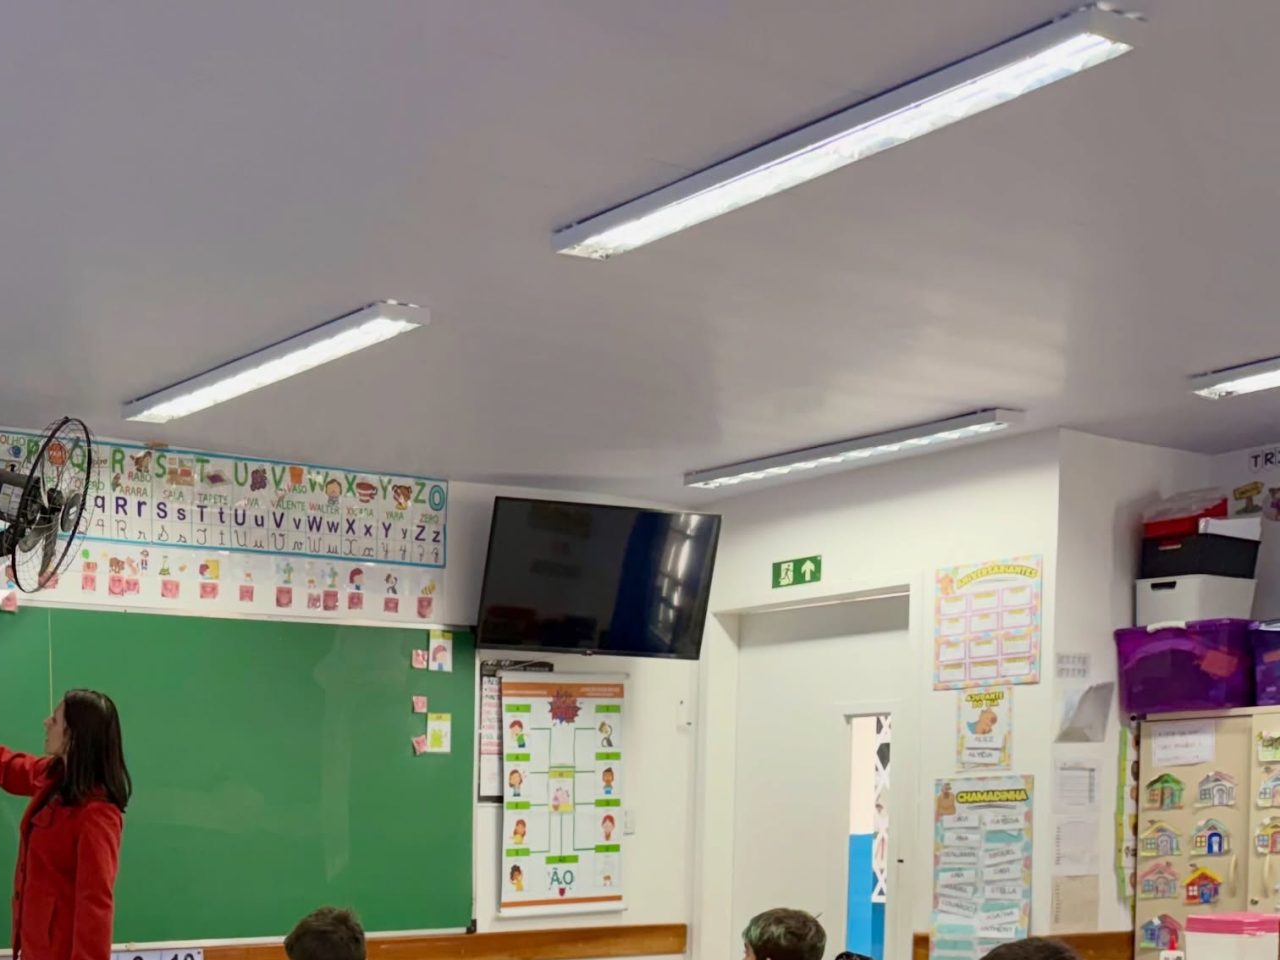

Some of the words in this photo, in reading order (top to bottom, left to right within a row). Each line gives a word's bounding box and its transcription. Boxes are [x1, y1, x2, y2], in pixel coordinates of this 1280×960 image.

[112, 448, 125, 474] R
[155, 453, 167, 478] S
[195, 457, 210, 482] T
[234, 462, 248, 486] U
[272, 466, 285, 490] V
[345, 474, 356, 497] X
[379, 476, 392, 500] Y
[413, 482, 426, 503] Z
[956, 788, 1028, 803] CHAMADINHA
